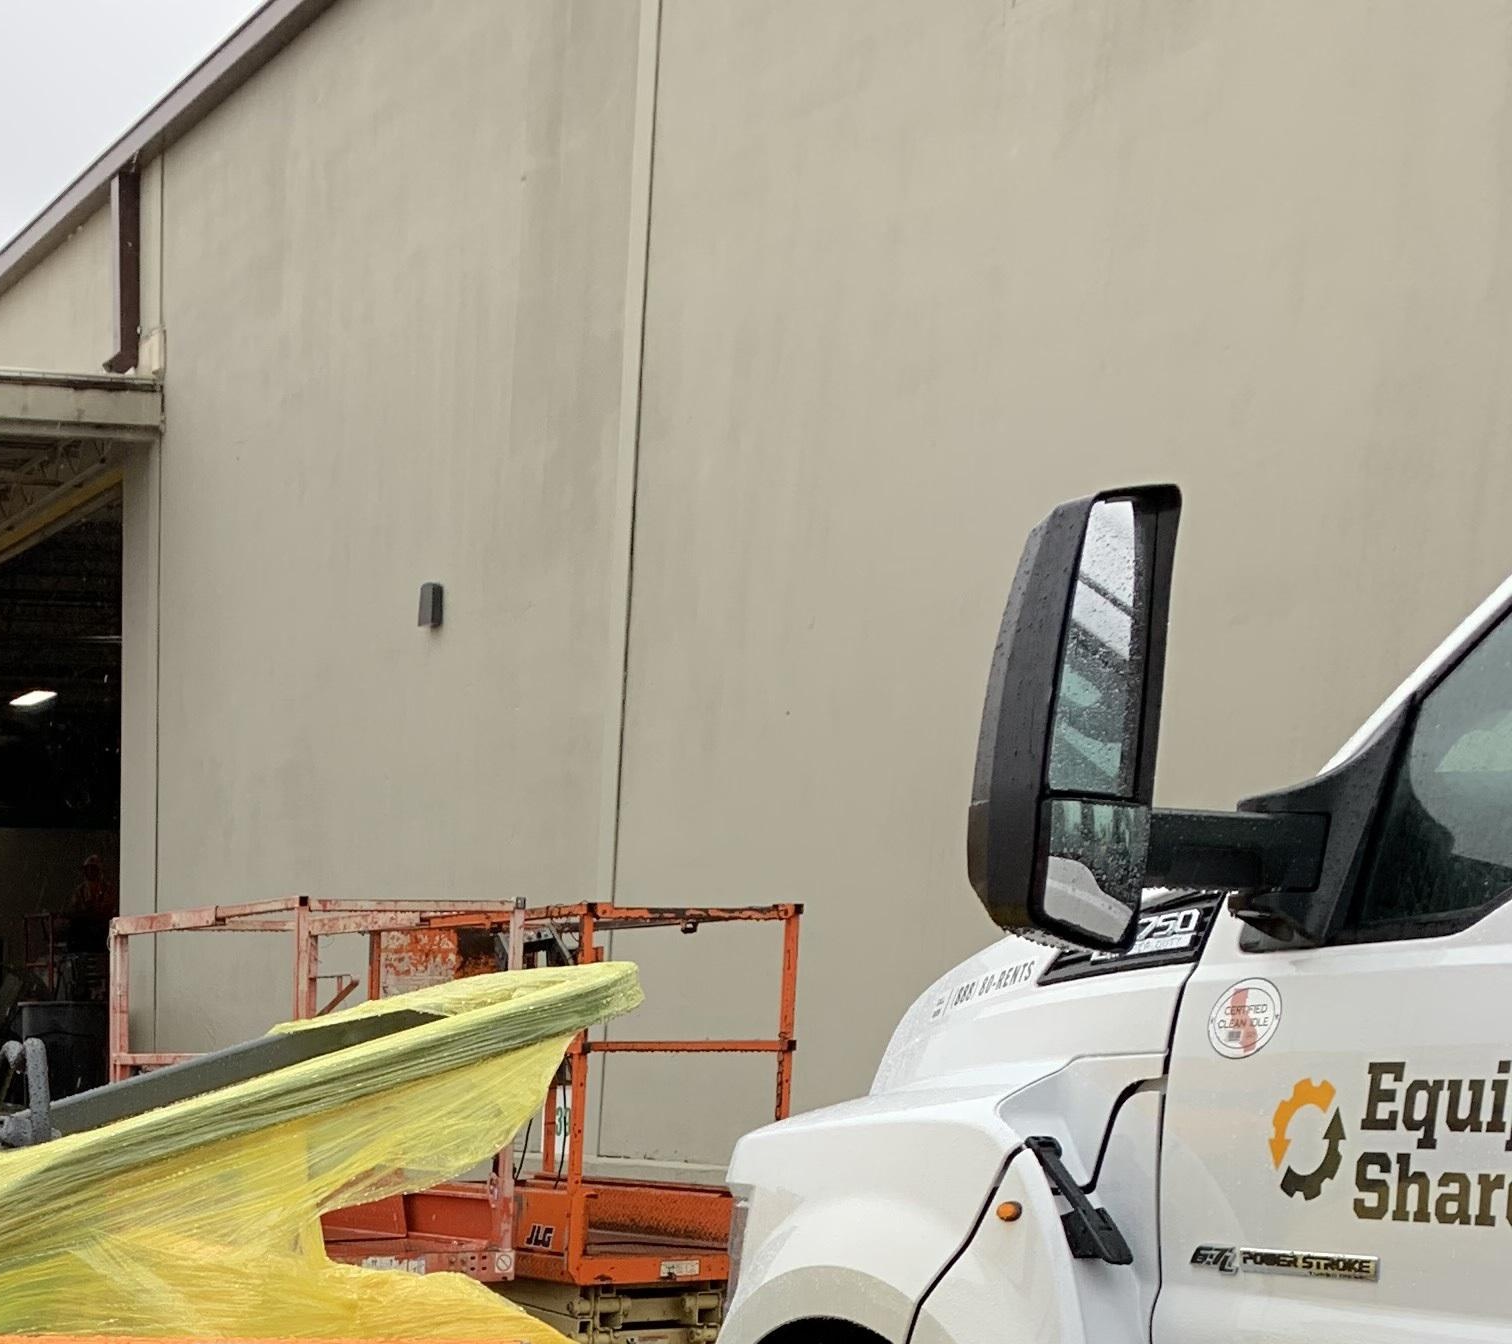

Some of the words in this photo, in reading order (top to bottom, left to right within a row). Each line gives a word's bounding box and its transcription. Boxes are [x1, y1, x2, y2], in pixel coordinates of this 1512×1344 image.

[1224, 1003, 1268, 1016] CERTIFIED
[1217, 1018, 1246, 1030] CLEAN
[1360, 1060, 1512, 1152] Equi
[1352, 1151, 1512, 1228] Shar
[525, 1224, 555, 1249] JLG
[1242, 1251, 1299, 1269] POWER
[1302, 1256, 1372, 1274] STROKE
